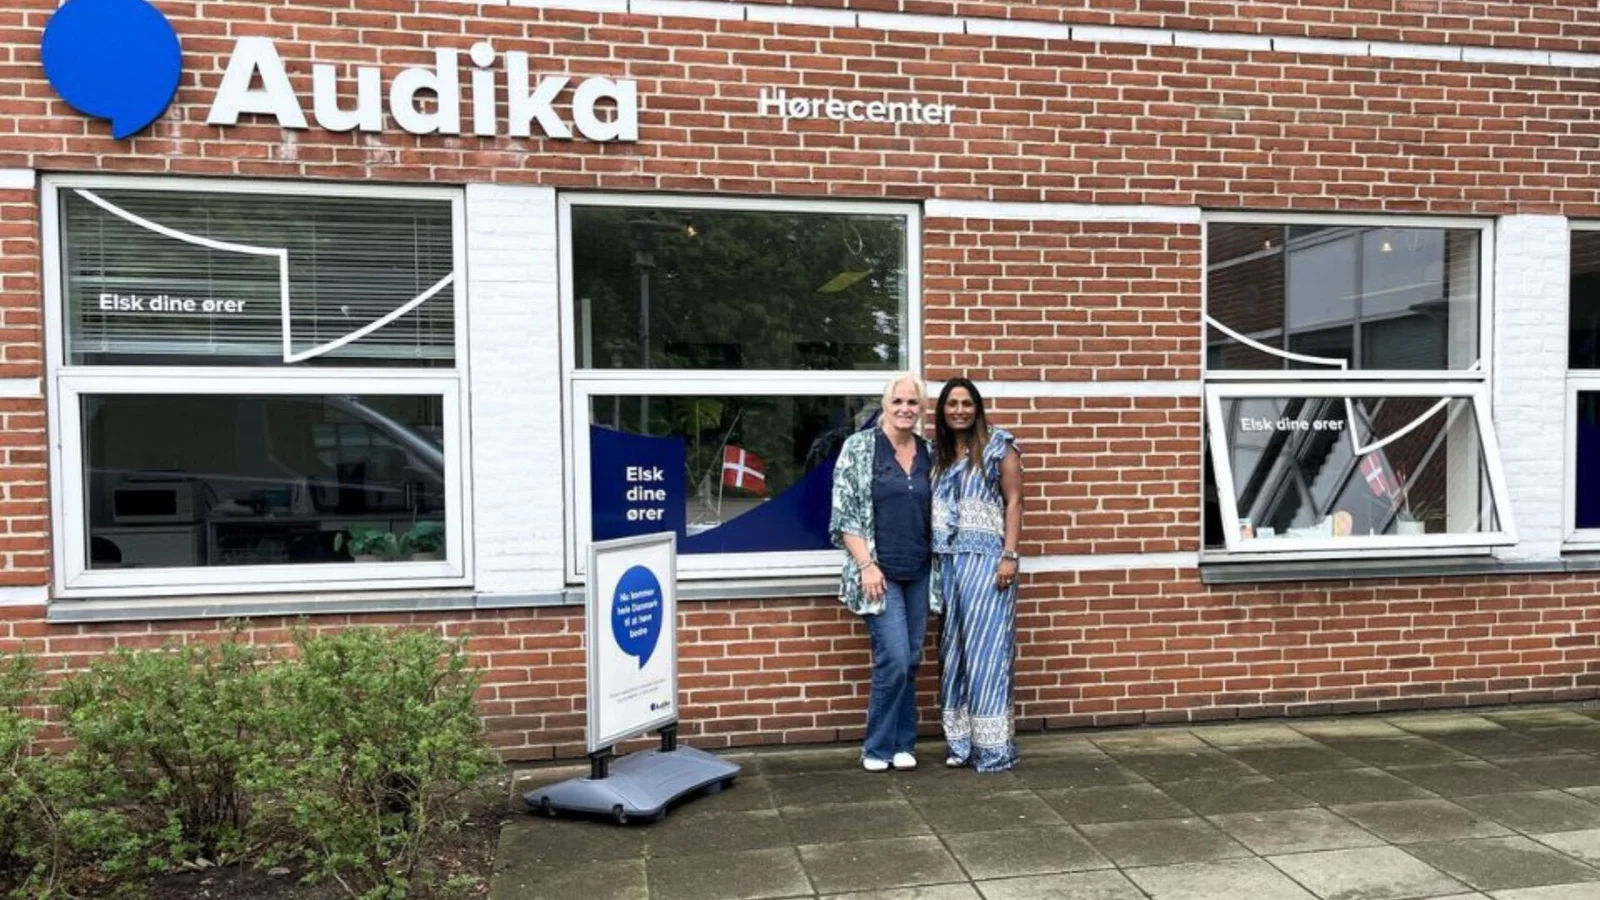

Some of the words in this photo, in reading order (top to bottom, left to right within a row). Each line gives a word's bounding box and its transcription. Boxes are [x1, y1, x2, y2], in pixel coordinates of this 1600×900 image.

[207, 36, 639, 141] Audika
[759, 88, 956, 124] Hørecenter
[99, 293, 144, 311] Elsk
[149, 294, 197, 311] dine
[202, 299, 246, 312] ører
[1241, 417, 1273, 431] Elsk
[1276, 416, 1309, 431] dine
[1312, 419, 1344, 431] ører
[626, 466, 664, 481] Elsk
[626, 485, 667, 501] dine
[626, 508, 664, 521] ører
[620, 592, 629, 602] Nu
[631, 599, 658, 612] Danmark
